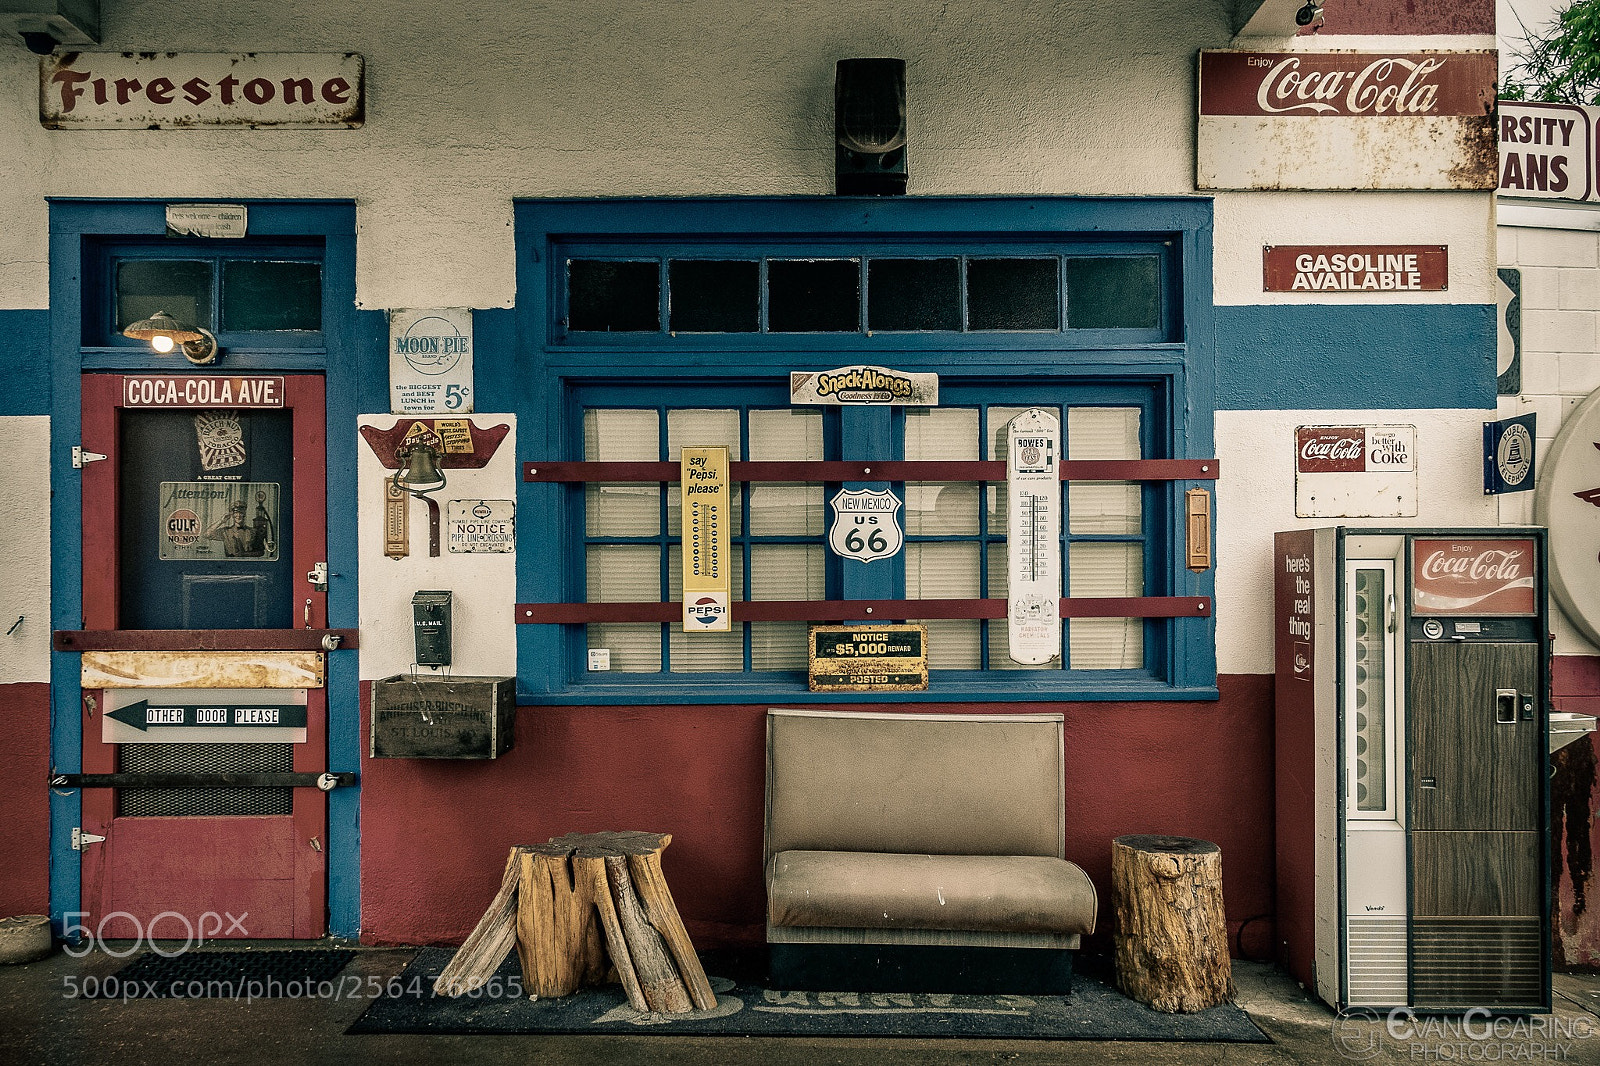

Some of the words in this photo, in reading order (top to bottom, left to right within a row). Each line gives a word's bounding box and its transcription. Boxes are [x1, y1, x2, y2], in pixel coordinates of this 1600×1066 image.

[1247, 57, 1273, 68] Enjoy
[52, 70, 350, 113] Firestone
[1257, 57, 1447, 113] Coca-Cola
[1501, 115, 1575, 146] RSITY
[1500, 152, 1568, 192] ANS
[218, 212, 241, 220] children
[1295, 254, 1418, 272] GASOLINE
[1291, 272, 1421, 290] AVAILABLE
[396, 336, 439, 354] MOON
[443, 336, 469, 354] PIE
[128, 380, 232, 403] COCA-COLA
[238, 380, 279, 403] AVE.
[840, 392, 872, 400] Goodness
[1371, 436, 1396, 445] better
[1503, 426, 1527, 441] PUBLIC
[208, 436, 239, 448] TOBACCO
[1018, 439, 1044, 447] BOWES
[1301, 438, 1363, 460] Coca-Cola
[1382, 440, 1405, 452] with
[690, 457, 707, 468] say
[1370, 449, 1408, 464] Coke
[687, 468, 718, 482] "Pepsi,
[1500, 458, 1530, 484] TELEPHONE
[164, 488, 229, 509] Attention!
[842, 498, 860, 509] NEW
[861, 498, 891, 509] MEXICO
[168, 519, 196, 532] GULF
[854, 516, 878, 525] US
[457, 525, 506, 533] NOTICE
[451, 534, 465, 542] PIPE
[467, 534, 480, 542] LINE
[484, 534, 513, 542] CROSSING
[845, 528, 888, 552] 66
[1286, 554, 1310, 573] here's
[1422, 550, 1524, 580] Coca-Cola
[1296, 575, 1310, 594] the
[688, 606, 726, 614] PEPSI
[1295, 596, 1311, 614] real
[1289, 616, 1310, 641] thing
[852, 633, 889, 641] NOTICE
[835, 643, 887, 656] $5,000
[850, 675, 889, 683] POSTED
[148, 709, 183, 722] OTHER
[198, 709, 227, 722] DOOR
[236, 709, 279, 722] PLEASE
